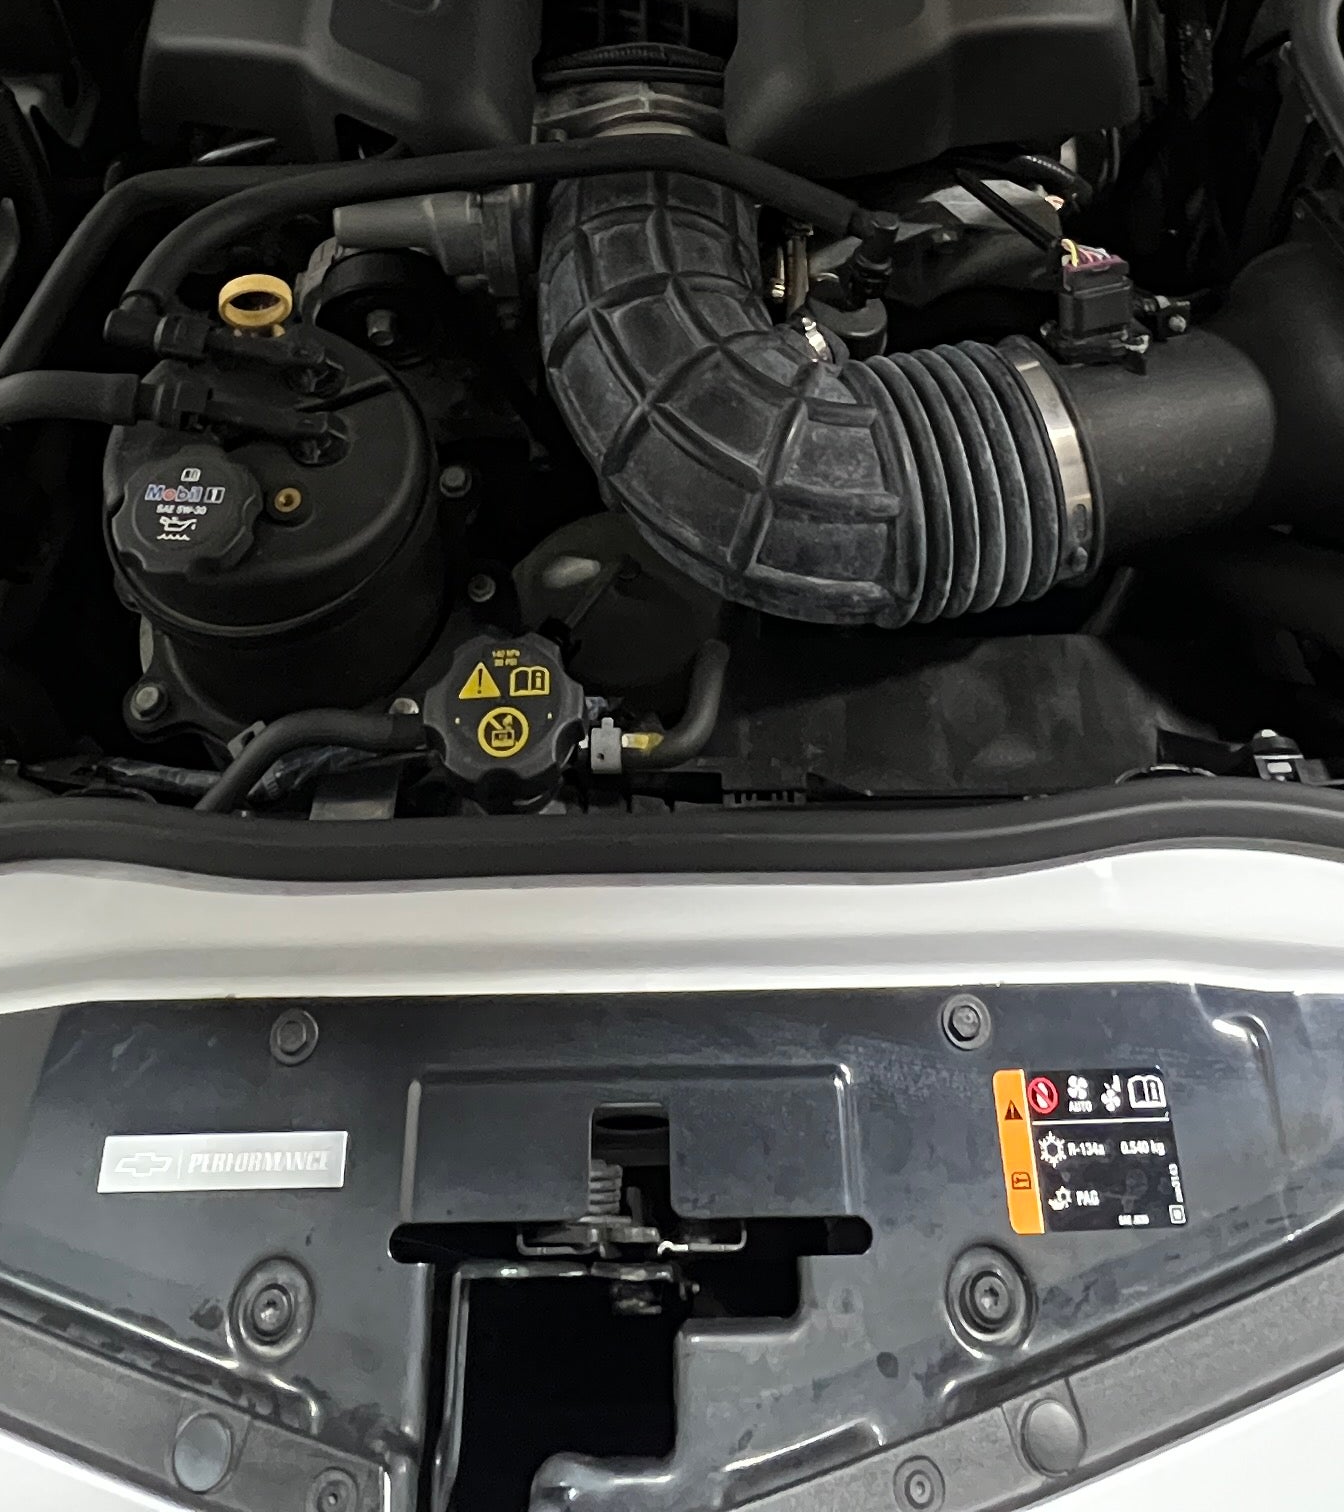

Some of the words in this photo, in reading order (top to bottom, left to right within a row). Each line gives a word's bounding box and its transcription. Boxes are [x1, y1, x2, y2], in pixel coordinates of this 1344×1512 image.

[144, 484, 204, 503] Mobil
[1068, 1101, 1093, 1113] AUTO
[1067, 1141, 1106, 1157] R-134a
[1149, 1139, 1166, 1157] kg
[187, 1150, 331, 1174] PERFORMANCE
[1076, 1189, 1100, 1207] PAG
